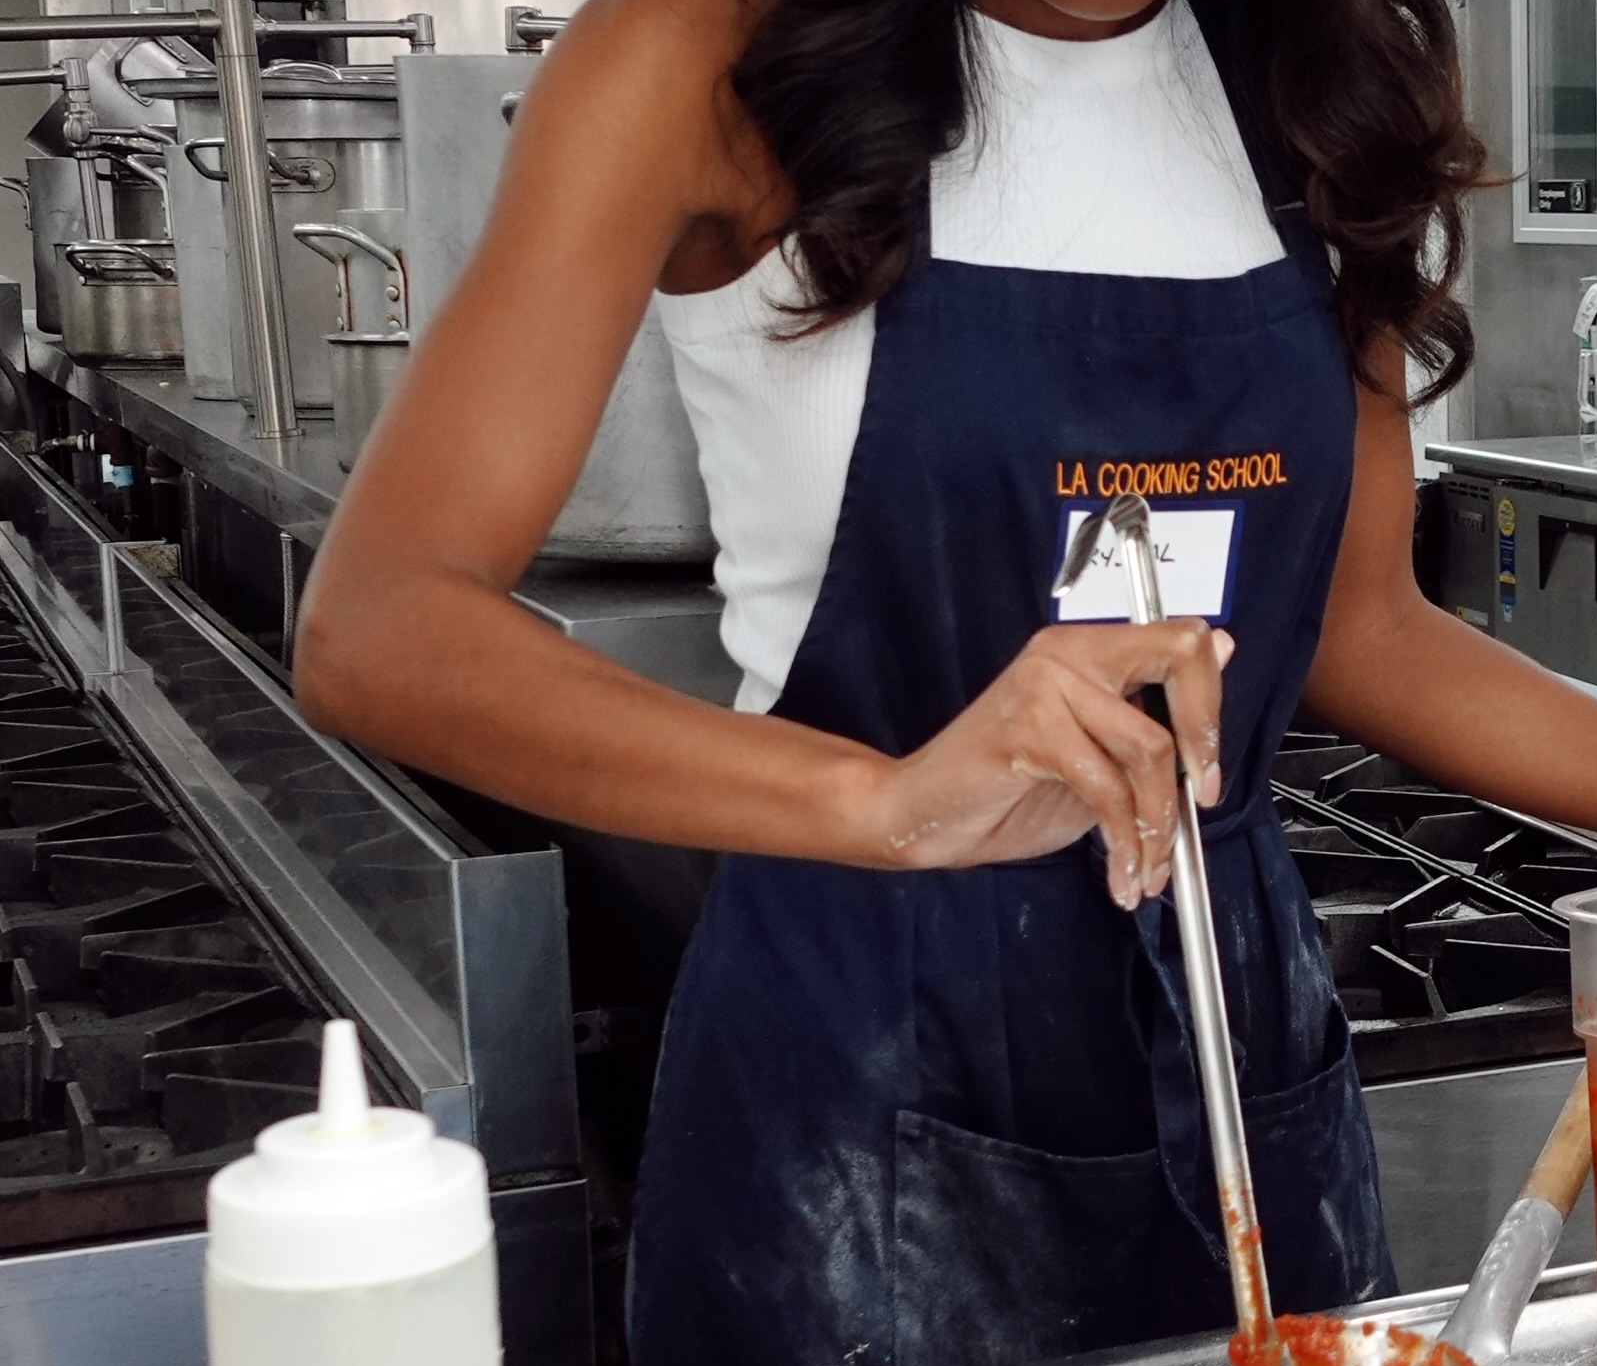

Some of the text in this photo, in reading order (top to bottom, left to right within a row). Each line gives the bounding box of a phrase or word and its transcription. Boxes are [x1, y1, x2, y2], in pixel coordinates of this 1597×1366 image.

[1057, 453, 1287, 497] LA COOKING SCHOOL
